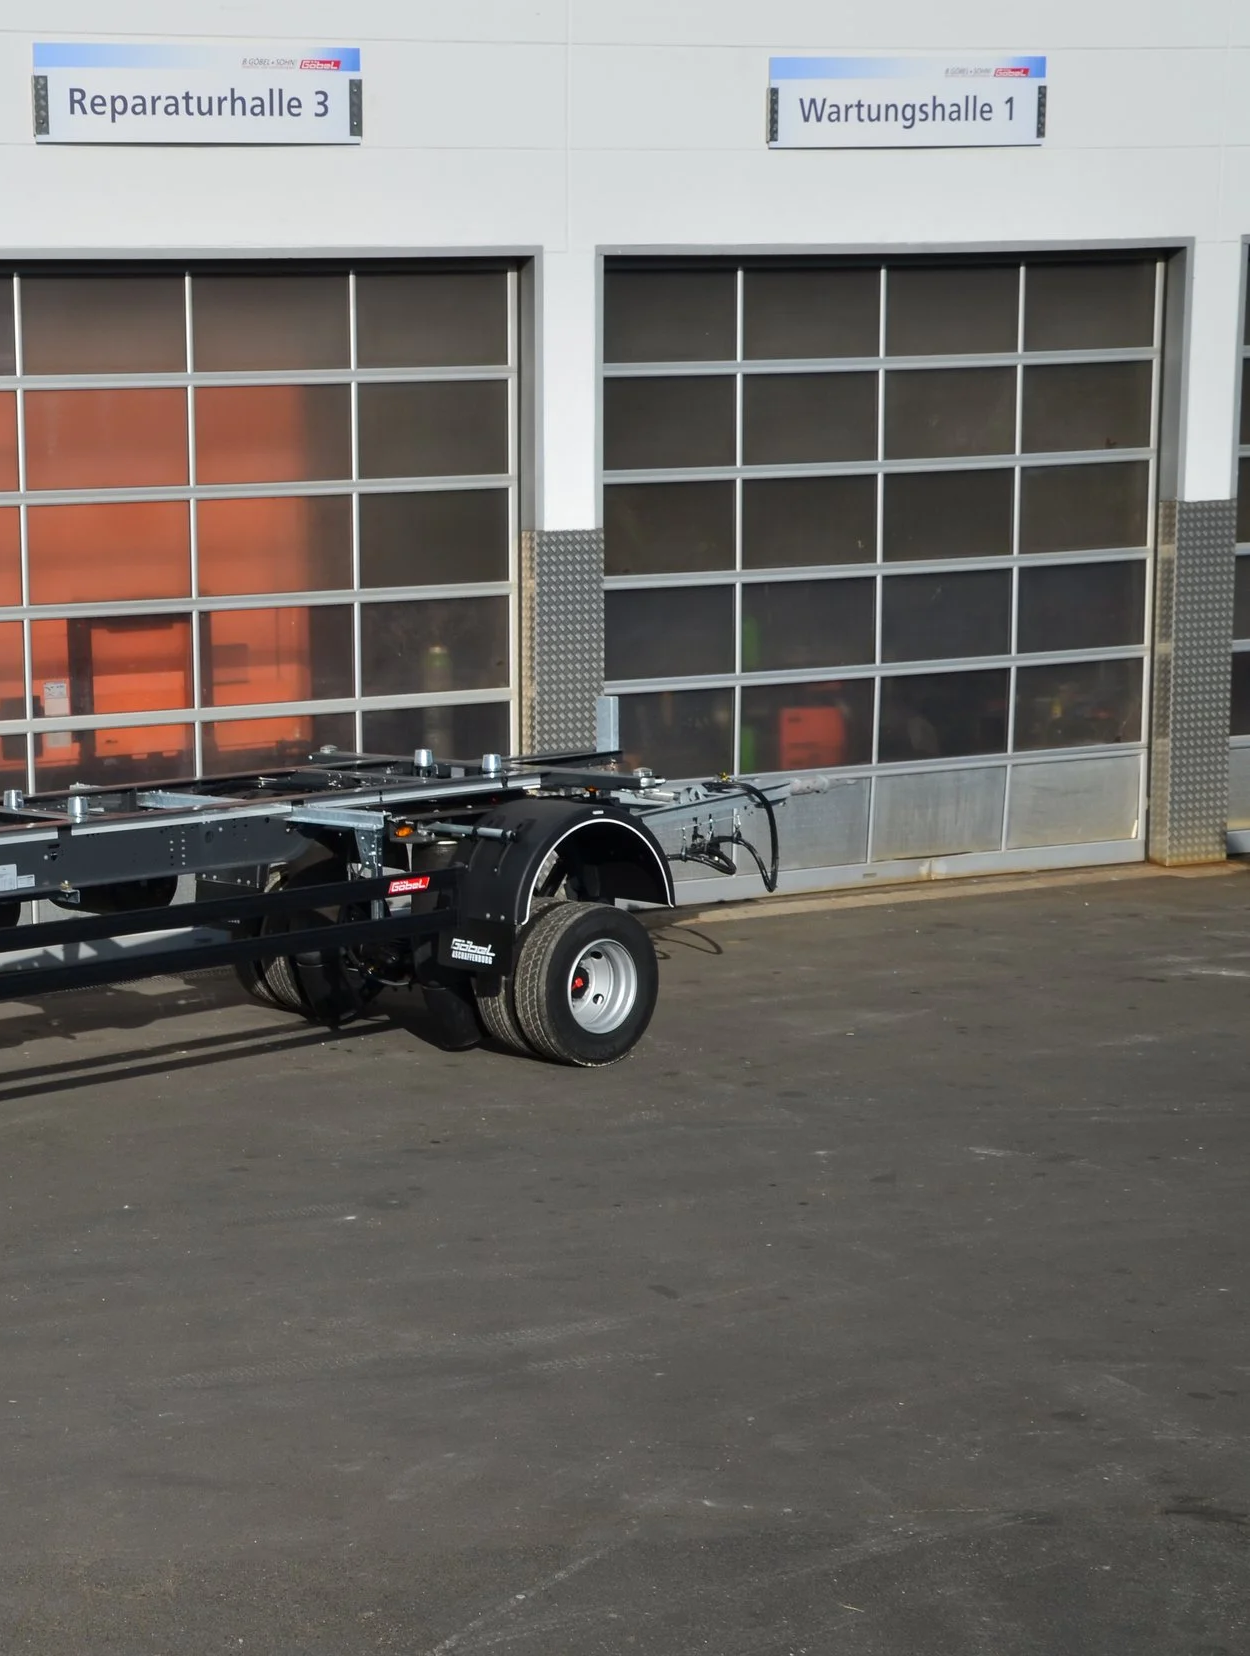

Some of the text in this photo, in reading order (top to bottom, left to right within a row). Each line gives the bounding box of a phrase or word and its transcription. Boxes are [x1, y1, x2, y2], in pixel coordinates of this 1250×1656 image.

[68, 87, 330, 123] Reparaturhalle 3
[799, 95, 1015, 129] Wartungshalle 1
